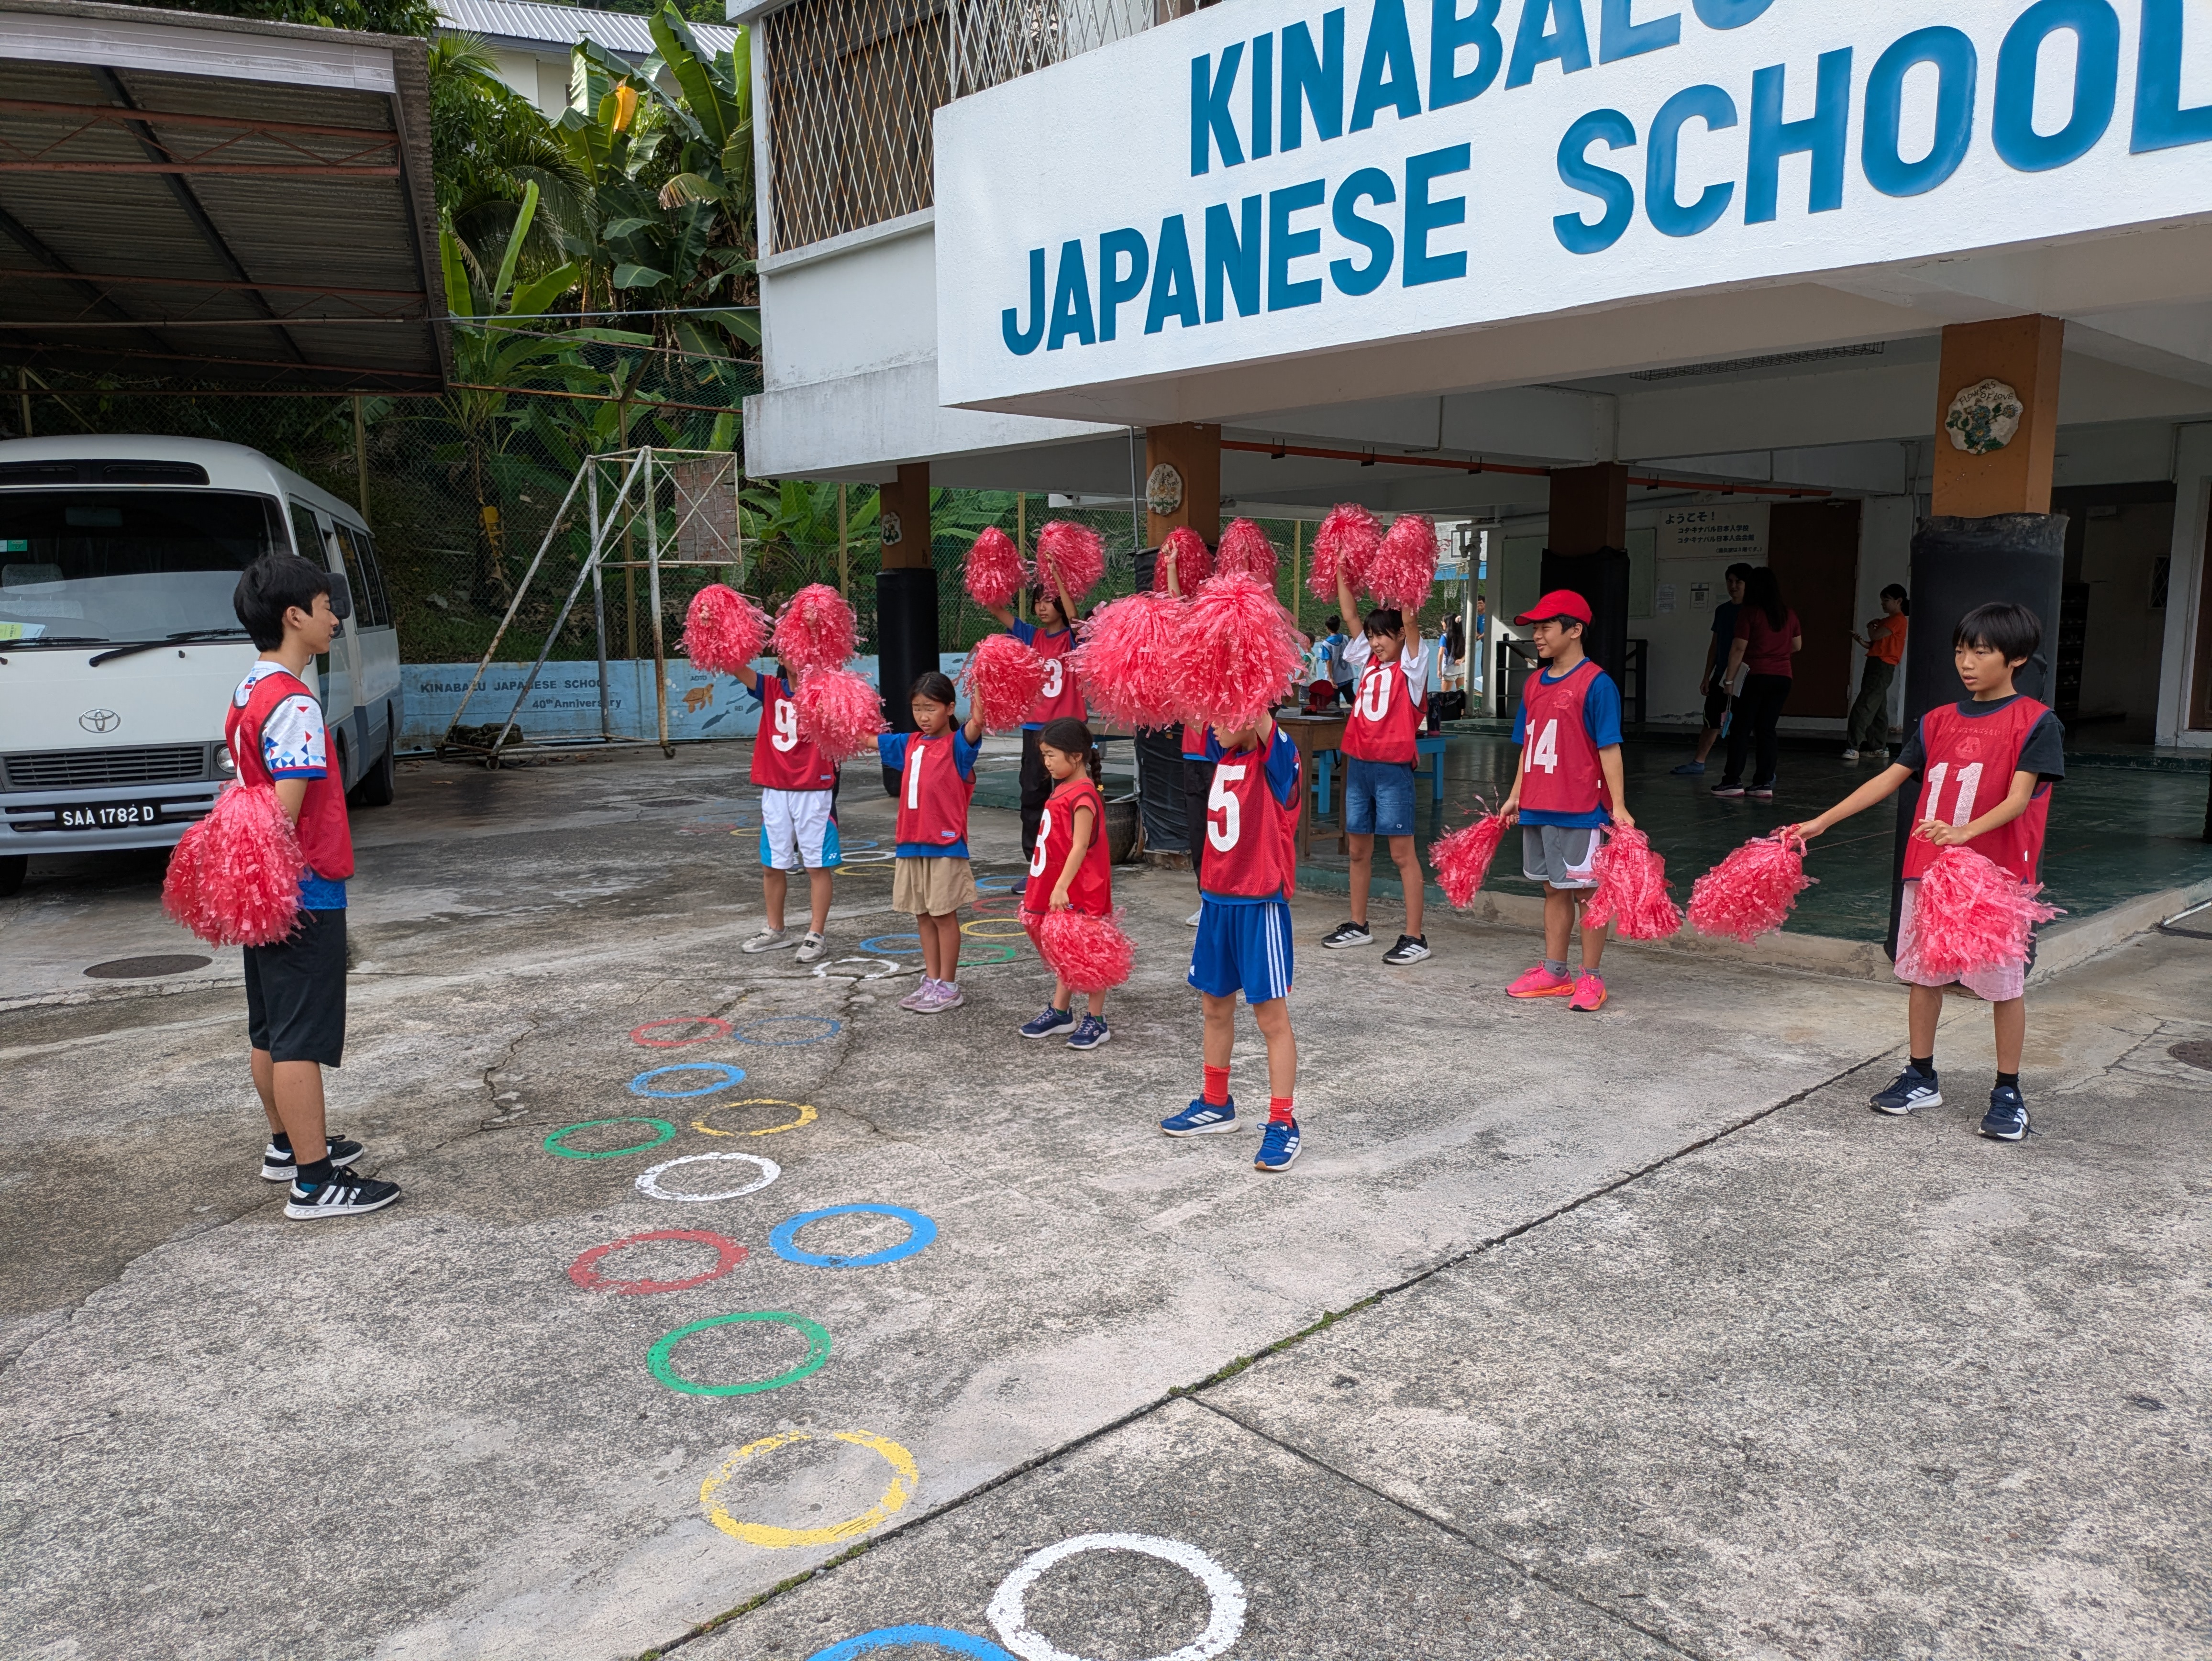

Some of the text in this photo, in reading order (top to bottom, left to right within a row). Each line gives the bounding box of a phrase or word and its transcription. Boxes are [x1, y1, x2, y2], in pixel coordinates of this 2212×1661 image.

[1191, 0, 1773, 177] KINABAL
[1002, 0, 2212, 356] JAPANESE SCHOOL
[1958, 380, 1996, 405] FLOWERS
[1980, 392, 2014, 401] OF LOVE
[532, 698, 622, 709] 40th Anniversry
[1354, 665, 1393, 721] 10
[772, 698, 798, 752] 9
[1524, 719, 1558, 774] 14
[908, 745, 926, 809] 1
[1925, 762, 1984, 828] 11
[63, 806, 154, 826] SAA 1782 D
[1207, 764, 1247, 852] 5
